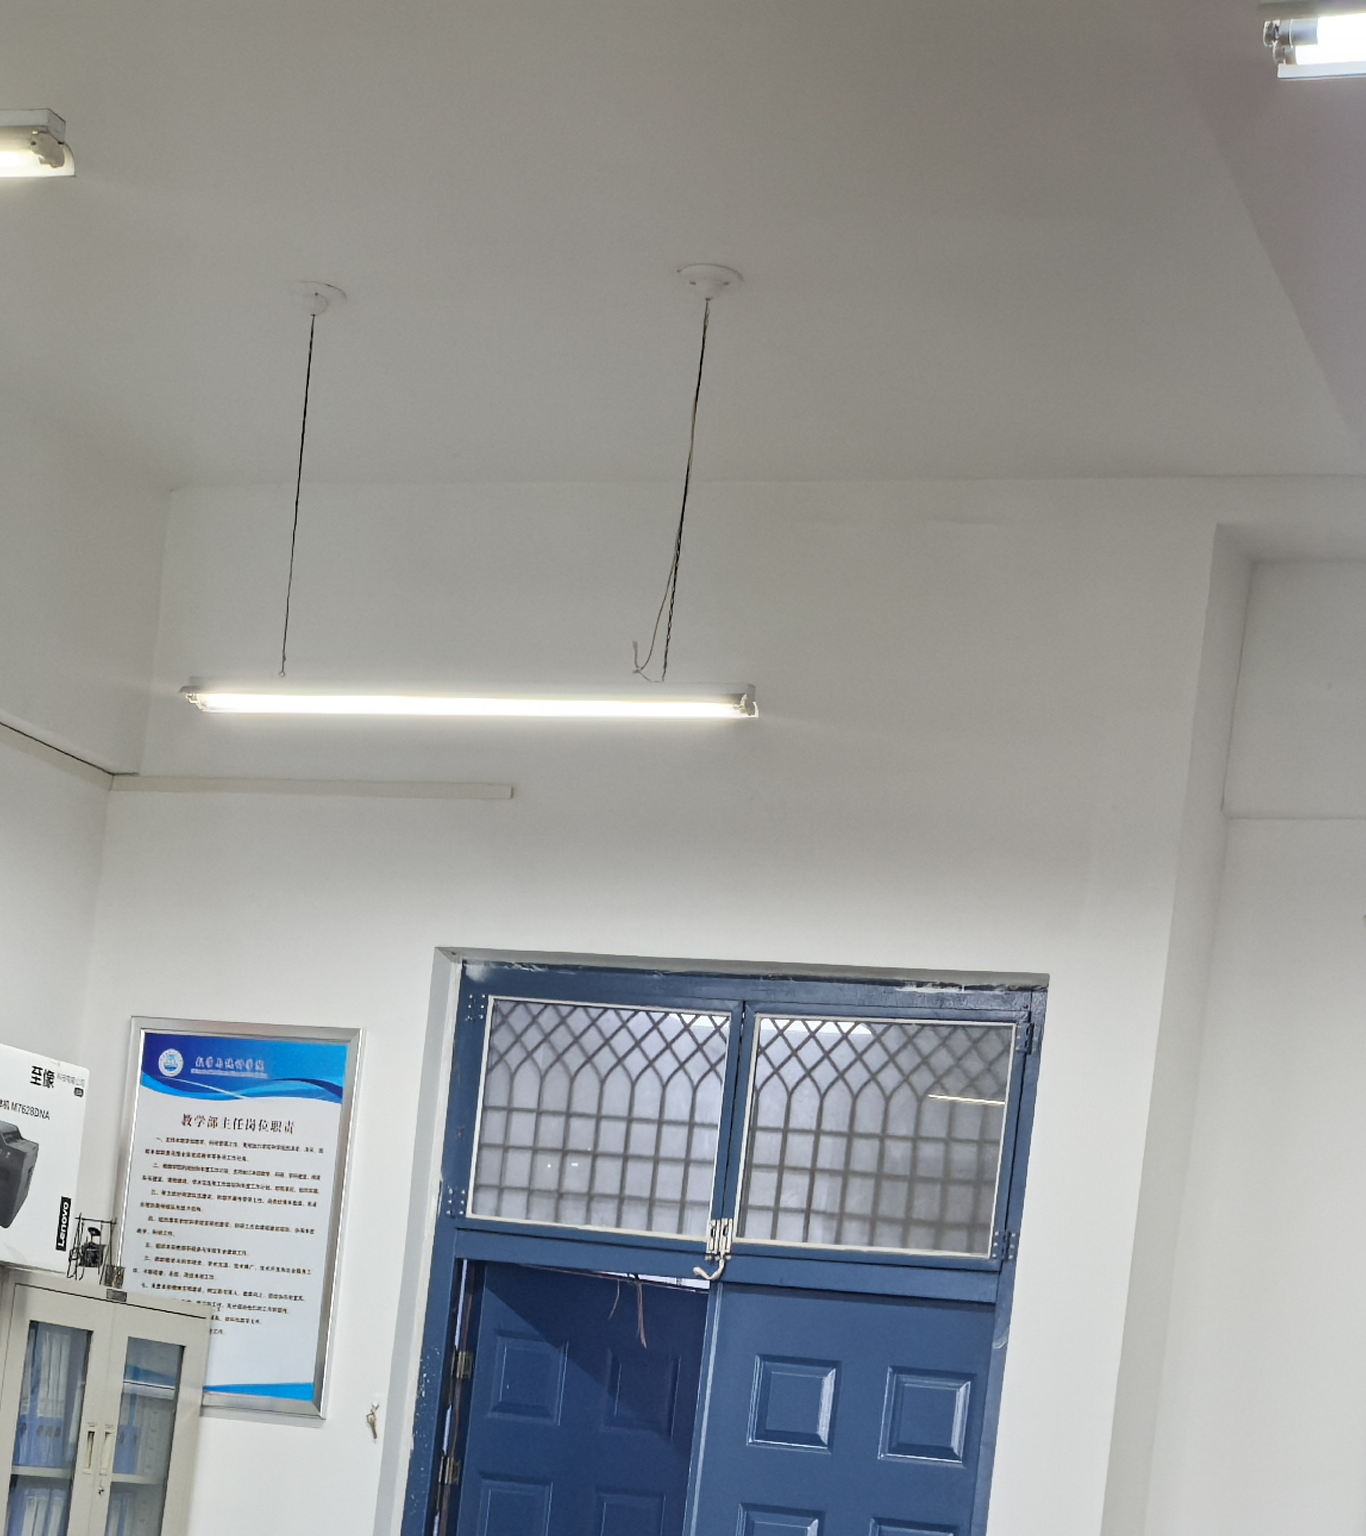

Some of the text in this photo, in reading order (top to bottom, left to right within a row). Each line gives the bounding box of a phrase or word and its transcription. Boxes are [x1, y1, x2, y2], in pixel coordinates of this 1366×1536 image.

[30, 1065, 55, 1089] 至像
[10, 1101, 51, 1121] M7628DNA
[181, 1112, 295, 1135] 教学部主任岗位职责
[56, 1200, 71, 1249] Lenovo
